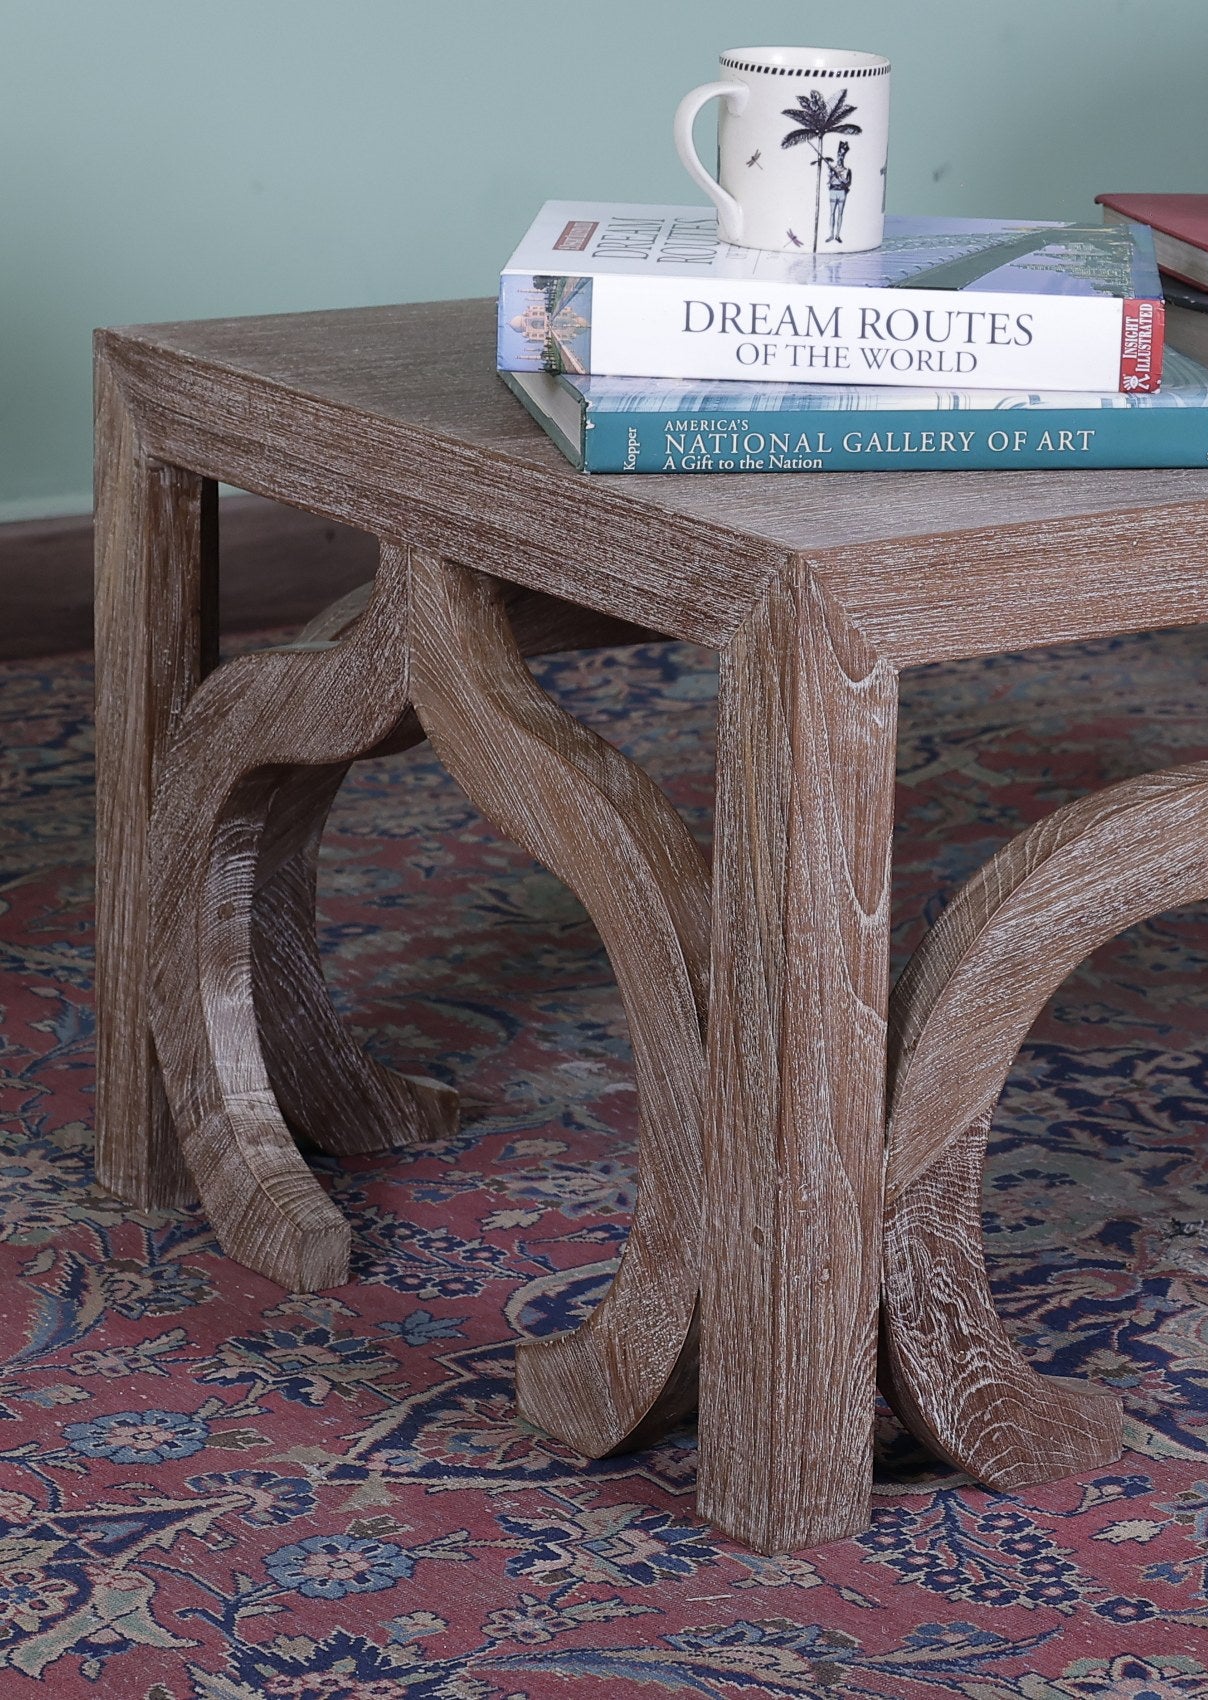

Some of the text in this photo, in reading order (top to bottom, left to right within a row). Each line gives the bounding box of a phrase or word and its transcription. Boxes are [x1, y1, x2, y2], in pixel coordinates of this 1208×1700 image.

[592, 216, 666, 260] DREAM
[656, 216, 721, 265] ROUTES
[681, 299, 1034, 347] DREAM ROUTES
[1122, 316, 1139, 359] INSIGHT
[1135, 303, 1153, 373] ILLUSTRATED
[735, 342, 978, 374] OF THE WORLD
[664, 419, 749, 432] AMERICA'S
[665, 429, 1096, 455] NATIONAL GALLERY OF ART
[623, 426, 641, 471] Kopper
[663, 454, 823, 470] A Gift to the Nation
